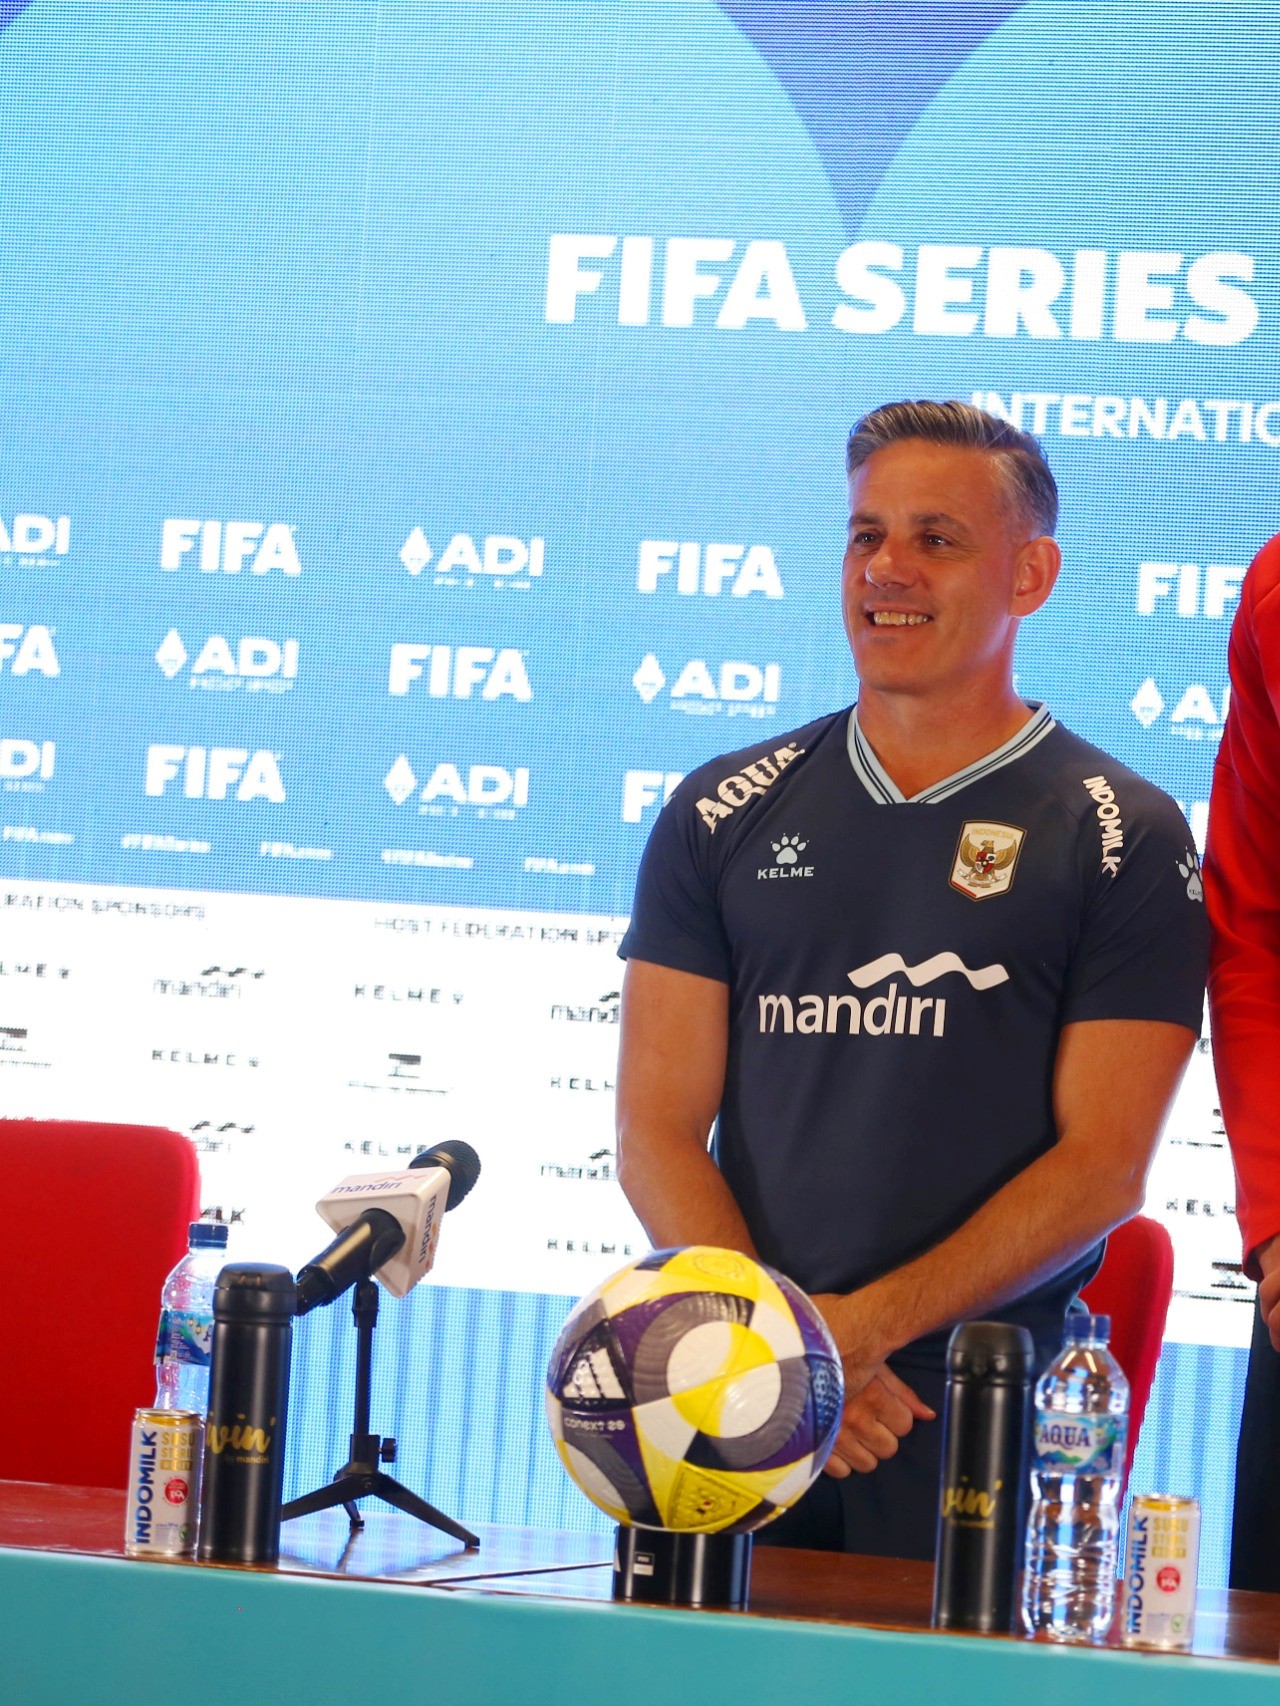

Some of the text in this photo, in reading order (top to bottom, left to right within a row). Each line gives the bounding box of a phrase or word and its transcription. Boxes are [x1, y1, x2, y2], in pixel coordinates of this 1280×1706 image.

[546, 234, 808, 332] FIFA
[831, 240, 1260, 347] SERIES
[160, 518, 302, 577] FIFA
[434, 532, 545, 577] ADI
[636, 539, 784, 599] FIFA
[192, 635, 300, 679] ADI
[388, 642, 532, 702] FIFA
[670, 659, 781, 703] ADI
[145, 743, 287, 803] FIFA
[420, 762, 530, 806] ADI
[1083, 775, 1124, 878] INDOMILK
[757, 866, 815, 880] KELME
[758, 983, 946, 1037] mandiri
[331, 1181, 402, 1194] mandiri
[419, 1194, 437, 1264] mandiri
[1039, 1423, 1092, 1450] AQUA
[135, 1430, 157, 1544] INDOMILK
[1126, 1515, 1149, 1634] INDOMILK
